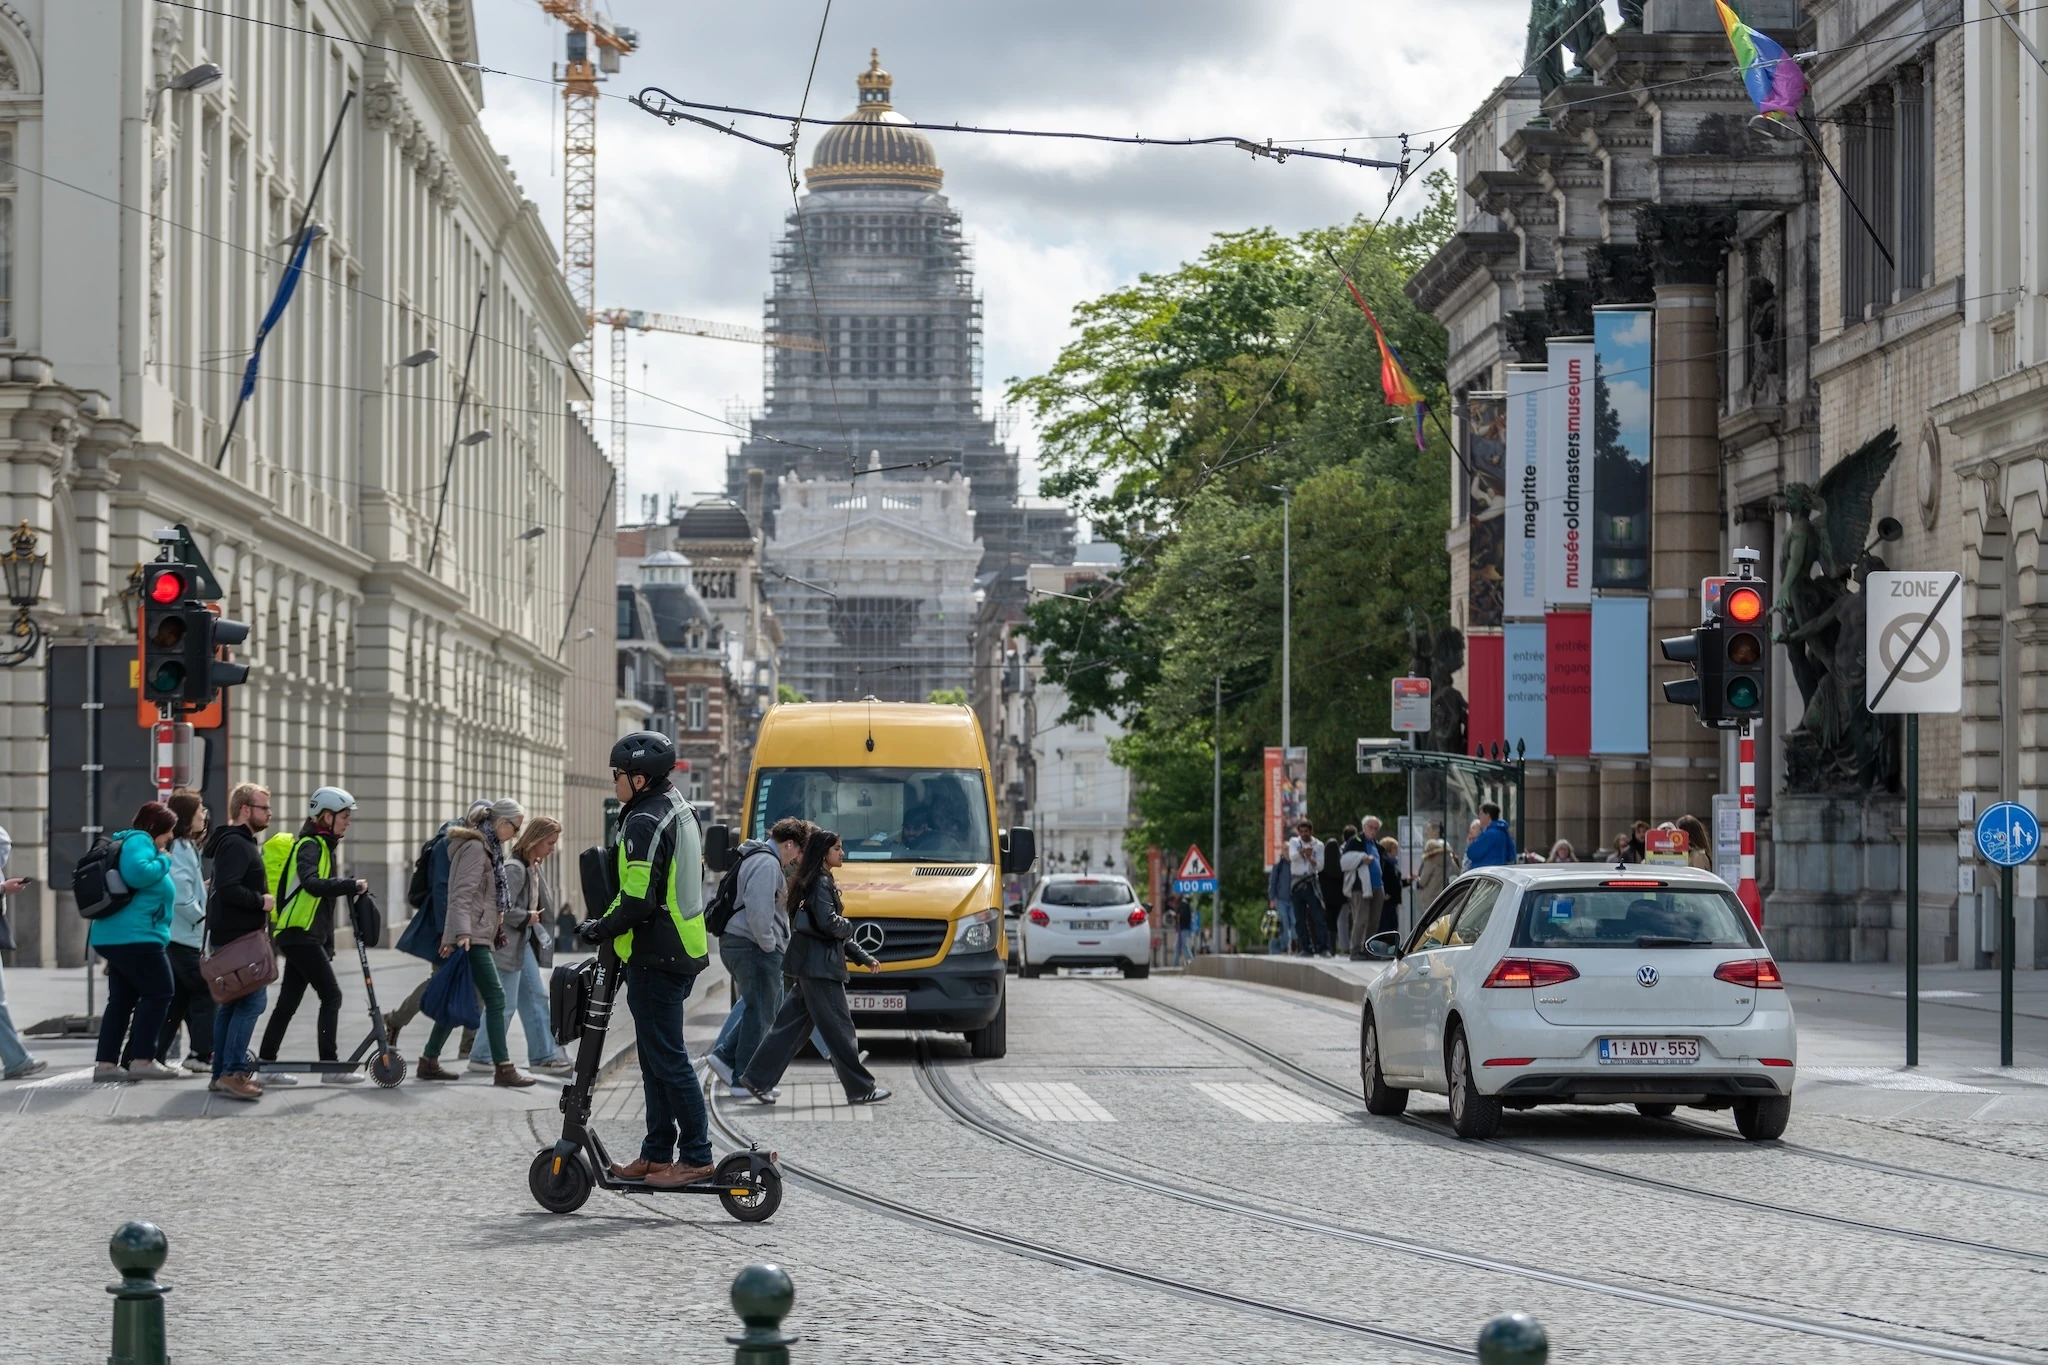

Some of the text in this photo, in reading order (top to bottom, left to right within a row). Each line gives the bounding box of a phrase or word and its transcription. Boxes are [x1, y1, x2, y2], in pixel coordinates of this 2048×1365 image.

[1890, 580, 1939, 598] ZONE
[1512, 670, 1546, 684] ingang
[1549, 683, 1592, 695] entranc
[1507, 690, 1547, 702] entranc
[836, 882, 911, 893] DHL
[1178, 881, 1213, 892] 100 m
[1552, 900, 1569, 918] L
